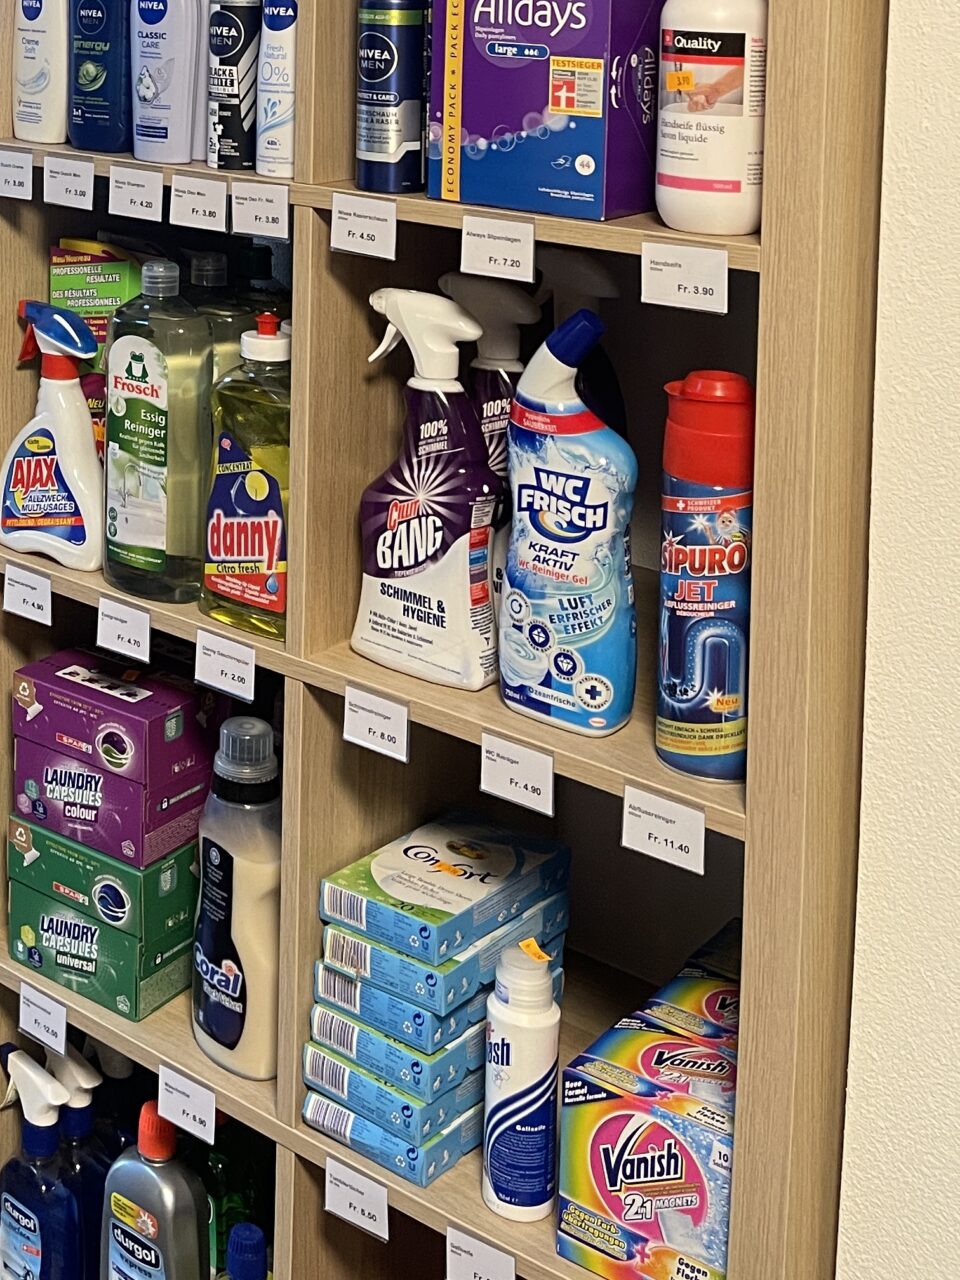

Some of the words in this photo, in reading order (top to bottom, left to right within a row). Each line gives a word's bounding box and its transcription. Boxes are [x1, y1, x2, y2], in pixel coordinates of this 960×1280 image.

[22, 0, 41, 8] NIVEA
[80, 9, 103, 17] NIVEA
[139, 1, 165, 11] NIVEA
[264, 7, 294, 16] NIVEA
[138, 31, 167, 40] CLASSIC
[210, 26, 238, 37] NIVEA
[141, 40, 160, 49] CARE
[266, 43, 284, 52] Fresh
[450, 24, 458, 58] PACK
[495, 43, 518, 56] large
[674, 35, 722, 52] Quality
[359, 49, 390, 60] NIVEA
[261, 61, 289, 82] 0%
[360, 59, 385, 70] MEN
[552, 59, 602, 70] TESTSIEGER
[449, 84, 457, 118] PACK
[695, 119, 725, 134] flüssig
[678, 132, 708, 144] liquide
[446, 125, 456, 193] ECONOMY
[359, 231, 376, 242] 4.50
[53, 265, 102, 275] PROFESSIONELLE
[502, 258, 521, 268] 7.20
[650, 259, 682, 269] Handseife
[86, 274, 120, 283] RESULTATE
[52, 290, 63, 298] DES
[677, 283, 691, 294] Fr.
[693, 285, 714, 296] 3.90
[113, 376, 160, 398] Frosch
[482, 398, 511, 419] 100%
[141, 409, 166, 427] Essig
[124, 420, 166, 438] Reiniger
[419, 419, 448, 440] 100%
[418, 441, 448, 456] SCHIMMEL
[218, 461, 253, 473] CONCENTRAT
[11, 457, 57, 497] AJAX
[539, 471, 583, 503] WC
[21, 502, 74, 512] MULTI-USAGES
[28, 493, 68, 503] ALLZWECK
[387, 499, 421, 531] CILLIT
[521, 488, 604, 529] FRISCH
[210, 512, 279, 571] danny
[376, 515, 443, 569] BANG
[528, 541, 580, 562] KRAFT
[661, 542, 747, 576] SIPURO
[216, 563, 236, 574] Citro
[237, 562, 260, 574] fresh
[532, 554, 574, 571] AKTIV
[532, 564, 570, 582] Reiniger
[572, 574, 588, 585] Gel
[380, 582, 434, 611] SCHIMMEL
[437, 600, 446, 614] &
[674, 580, 718, 601] JET
[548, 598, 612, 624] ERFRISCHER
[558, 594, 594, 612] LUFT
[402, 604, 447, 629] HYGIENE
[564, 616, 605, 635] EFFEKT
[127, 637, 141, 648] 4.70
[231, 673, 246, 685] 2.00
[528, 687, 576, 708] Ozeanfrische
[716, 698, 738, 706] Neu
[380, 731, 397, 744] 8.00
[485, 748, 496, 757] WC
[44, 767, 103, 792] LAUNDRY
[509, 777, 522, 789] Fr.
[523, 782, 541, 796] 4.90
[46, 784, 102, 807] CAPSULES
[64, 805, 97, 820] colour
[648, 832, 661, 845] Fr.
[663, 838, 690, 854] 11.40
[40, 915, 99, 944] LAUNDRY
[42, 933, 98, 959] CAPSULES
[56, 953, 96, 973] universal
[194, 942, 242, 997] Coral
[653, 1048, 730, 1075] Vanish
[600, 1121, 682, 1192] Vanish
[717, 1150, 729, 1163] 10
[654, 1195, 698, 1210] MAGNETS
[4, 1201, 35, 1231] durgol
[113, 1227, 156, 1264] durgol
[678, 1257, 708, 1278] Gegen
